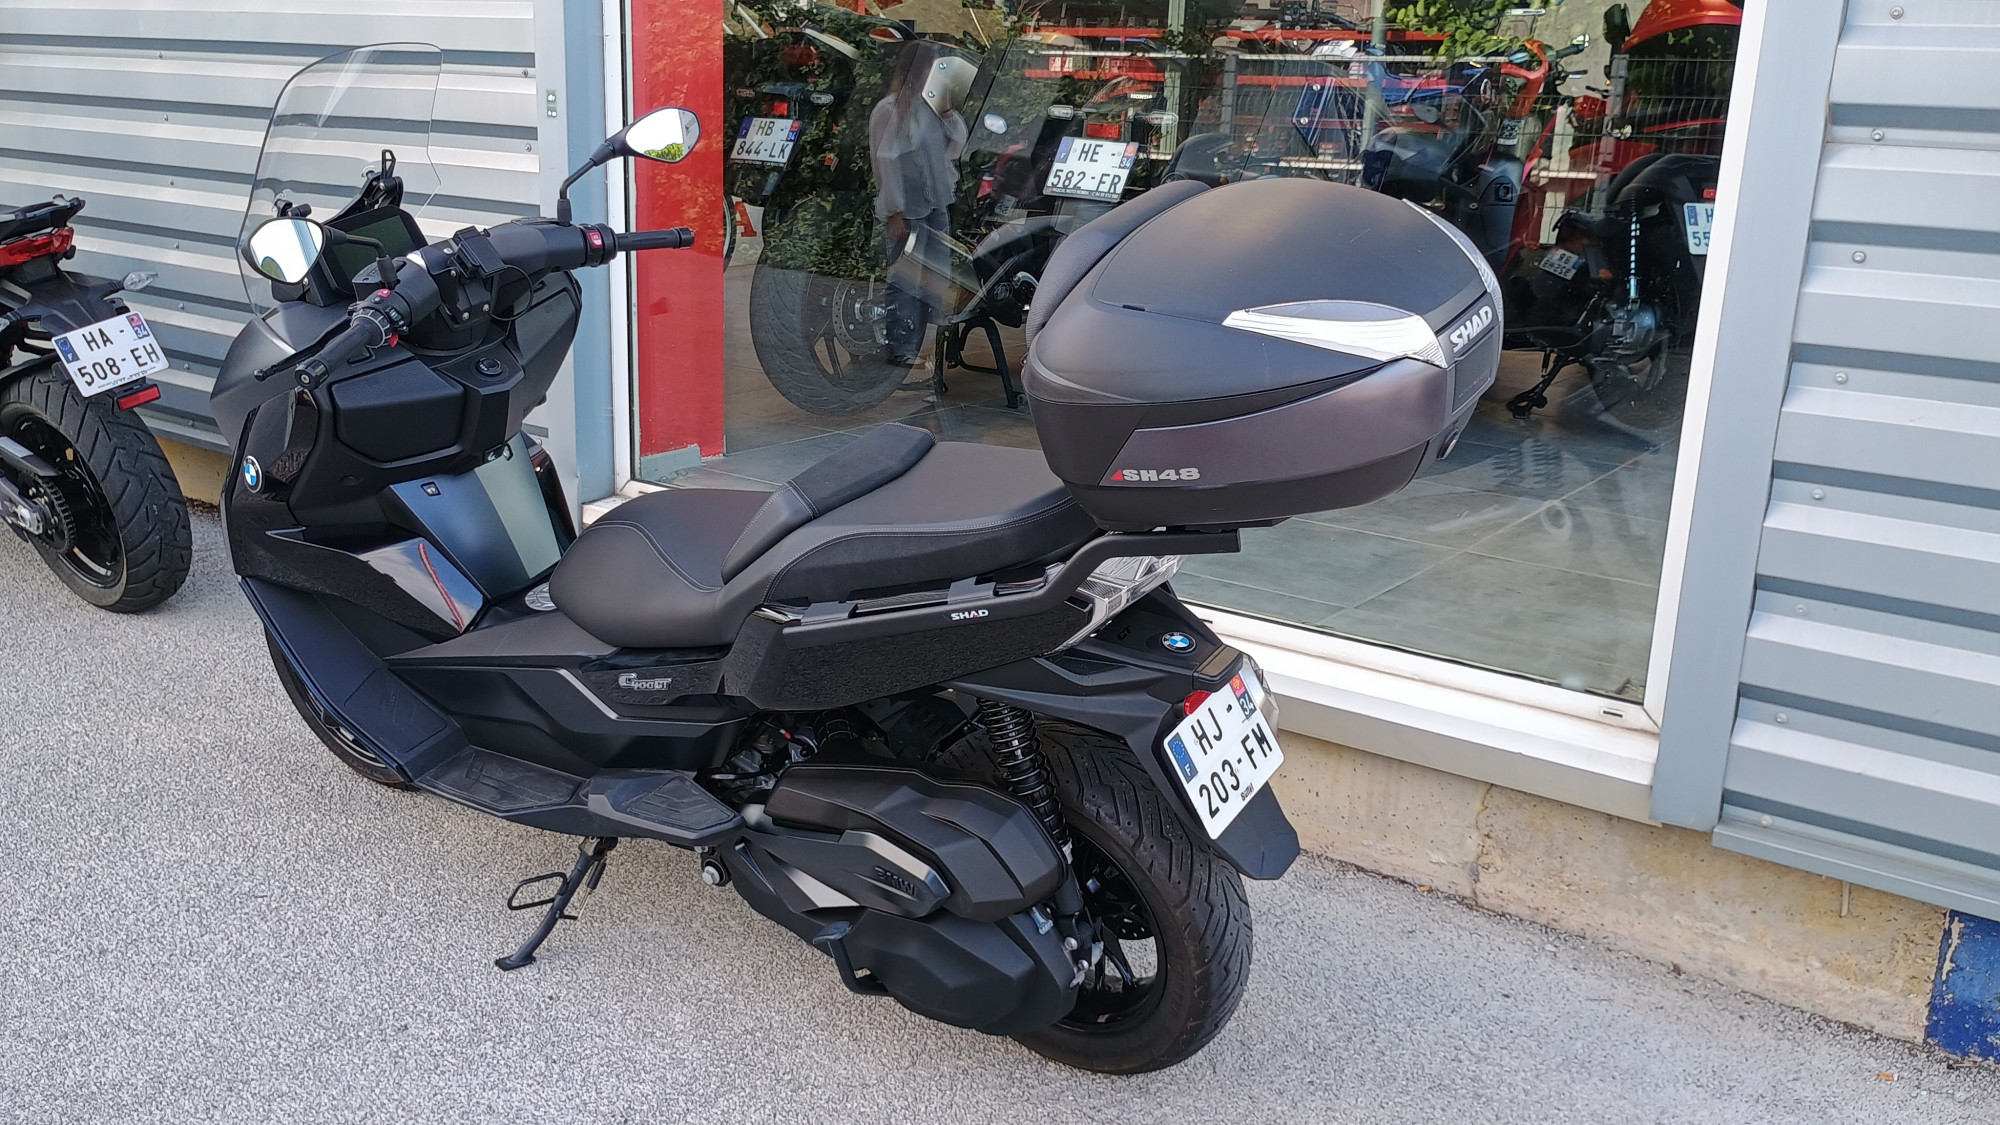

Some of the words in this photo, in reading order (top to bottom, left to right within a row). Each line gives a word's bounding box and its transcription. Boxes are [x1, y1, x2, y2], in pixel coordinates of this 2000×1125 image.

[756, 121, 775, 136] HB
[1060, 152, 1066, 160] F
[1077, 142, 1104, 163] HE
[1120, 157, 1131, 167] 34
[134, 326, 147, 338] 34
[1450, 305, 1493, 353] SHAD
[82, 328, 113, 352] HA
[1122, 467, 1200, 482] SH48
[951, 609, 989, 621] SHAD
[1239, 696, 1255, 716] 34
[1191, 707, 1223, 756] HJ
[1184, 763, 1192, 777] F
